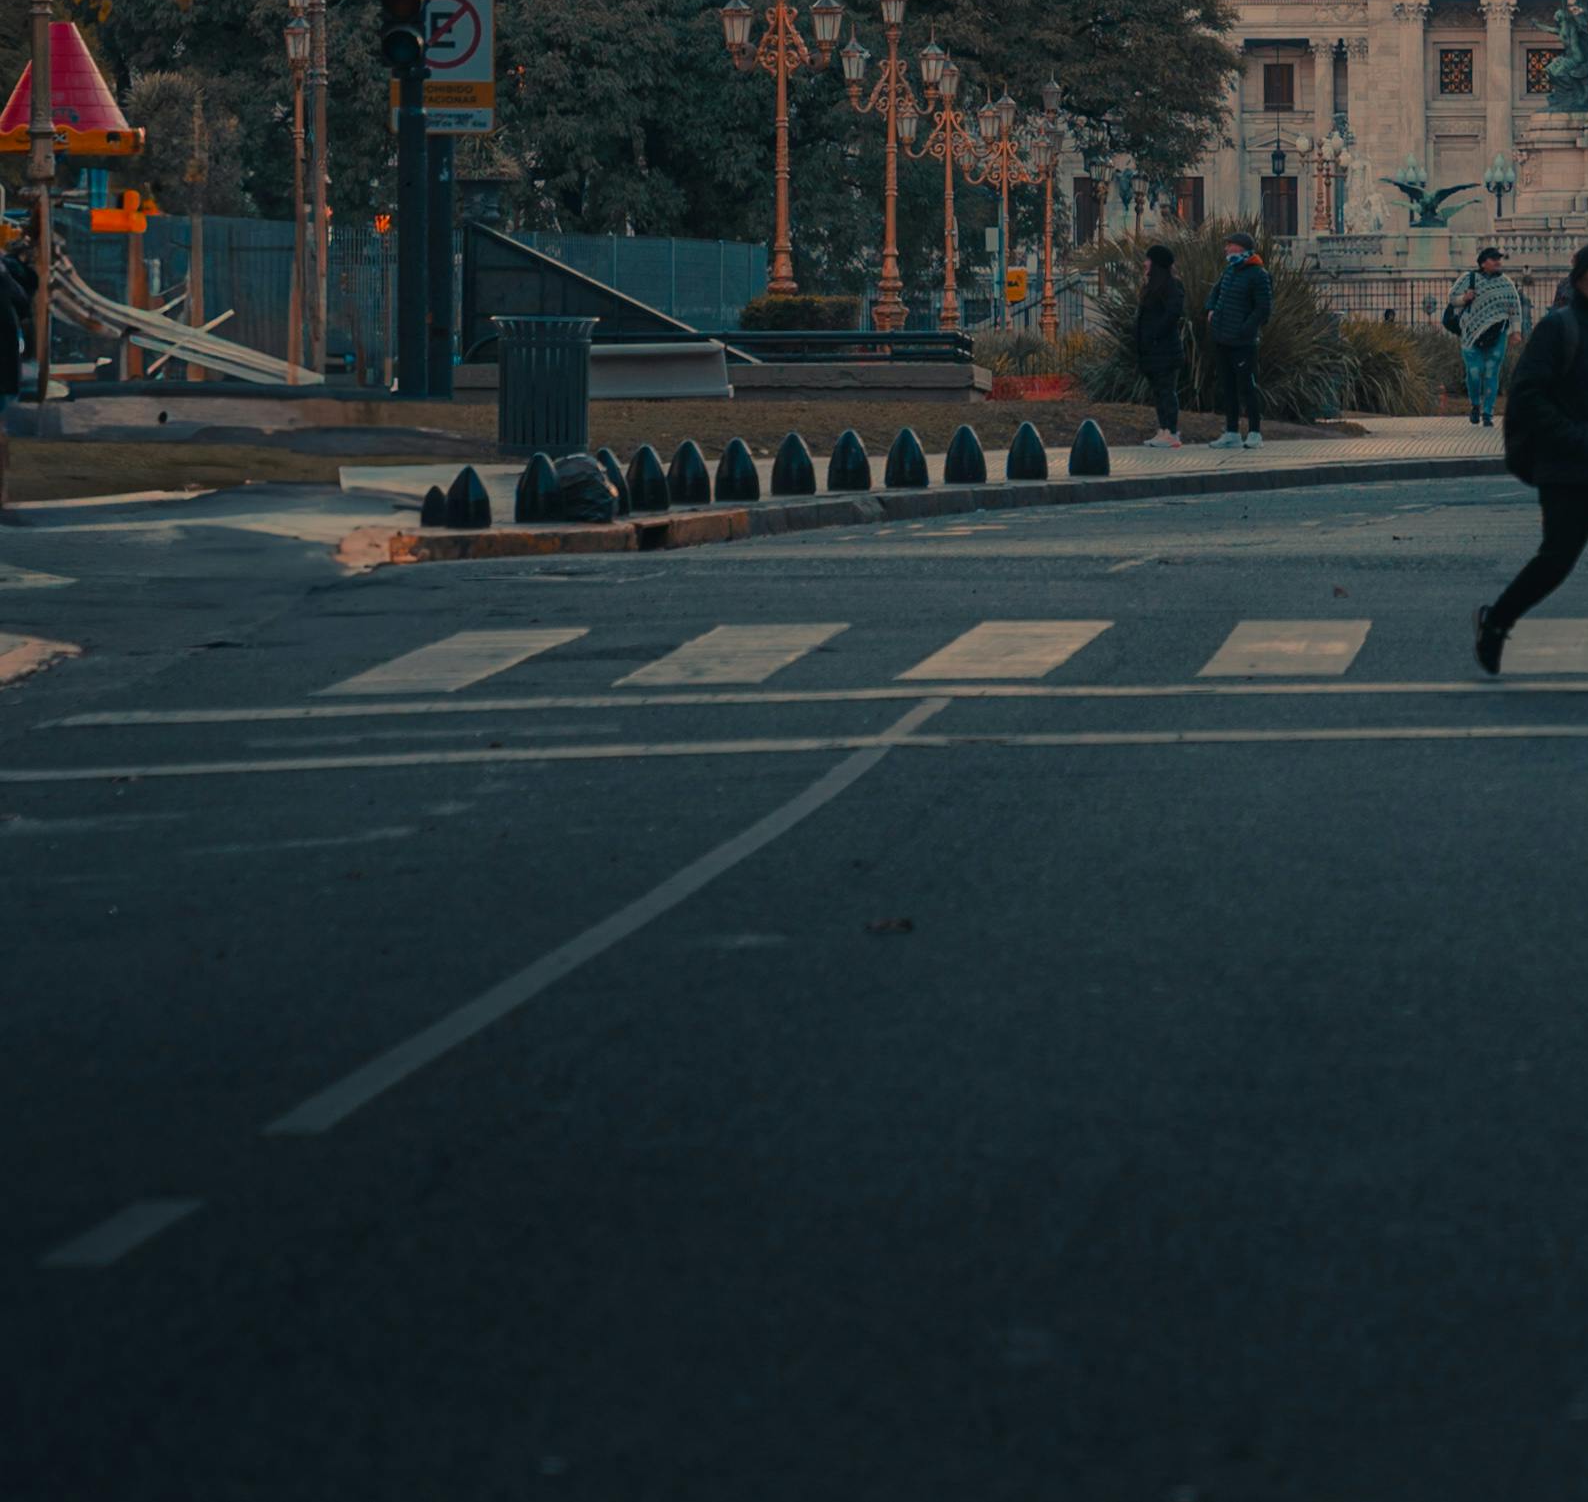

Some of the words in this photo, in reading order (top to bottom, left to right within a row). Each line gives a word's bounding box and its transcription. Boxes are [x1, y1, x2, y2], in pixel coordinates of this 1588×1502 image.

[431, 12, 455, 48] E
[426, 84, 474, 94] OHIBIDO
[423, 94, 477, 104] TACIONAR
